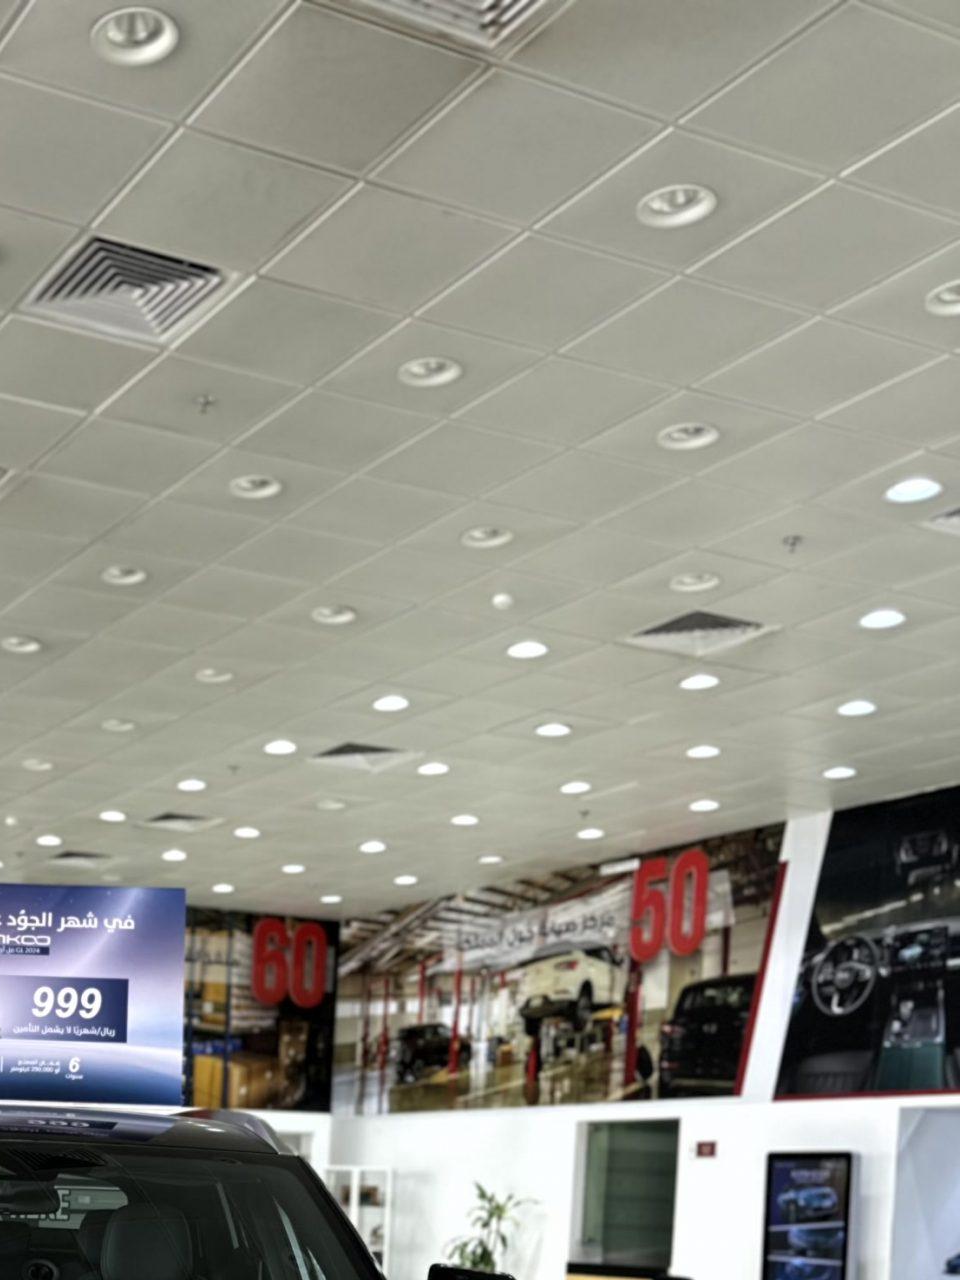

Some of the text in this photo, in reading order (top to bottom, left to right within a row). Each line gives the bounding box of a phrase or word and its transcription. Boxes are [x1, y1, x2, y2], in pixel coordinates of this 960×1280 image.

[630, 848, 710, 963] 50
[56, 910, 98, 932] شهر
[104, 914, 136, 933] في
[251, 916, 329, 1009] 60
[31, 985, 102, 1020] 999
[68, 1056, 81, 1073] 6
